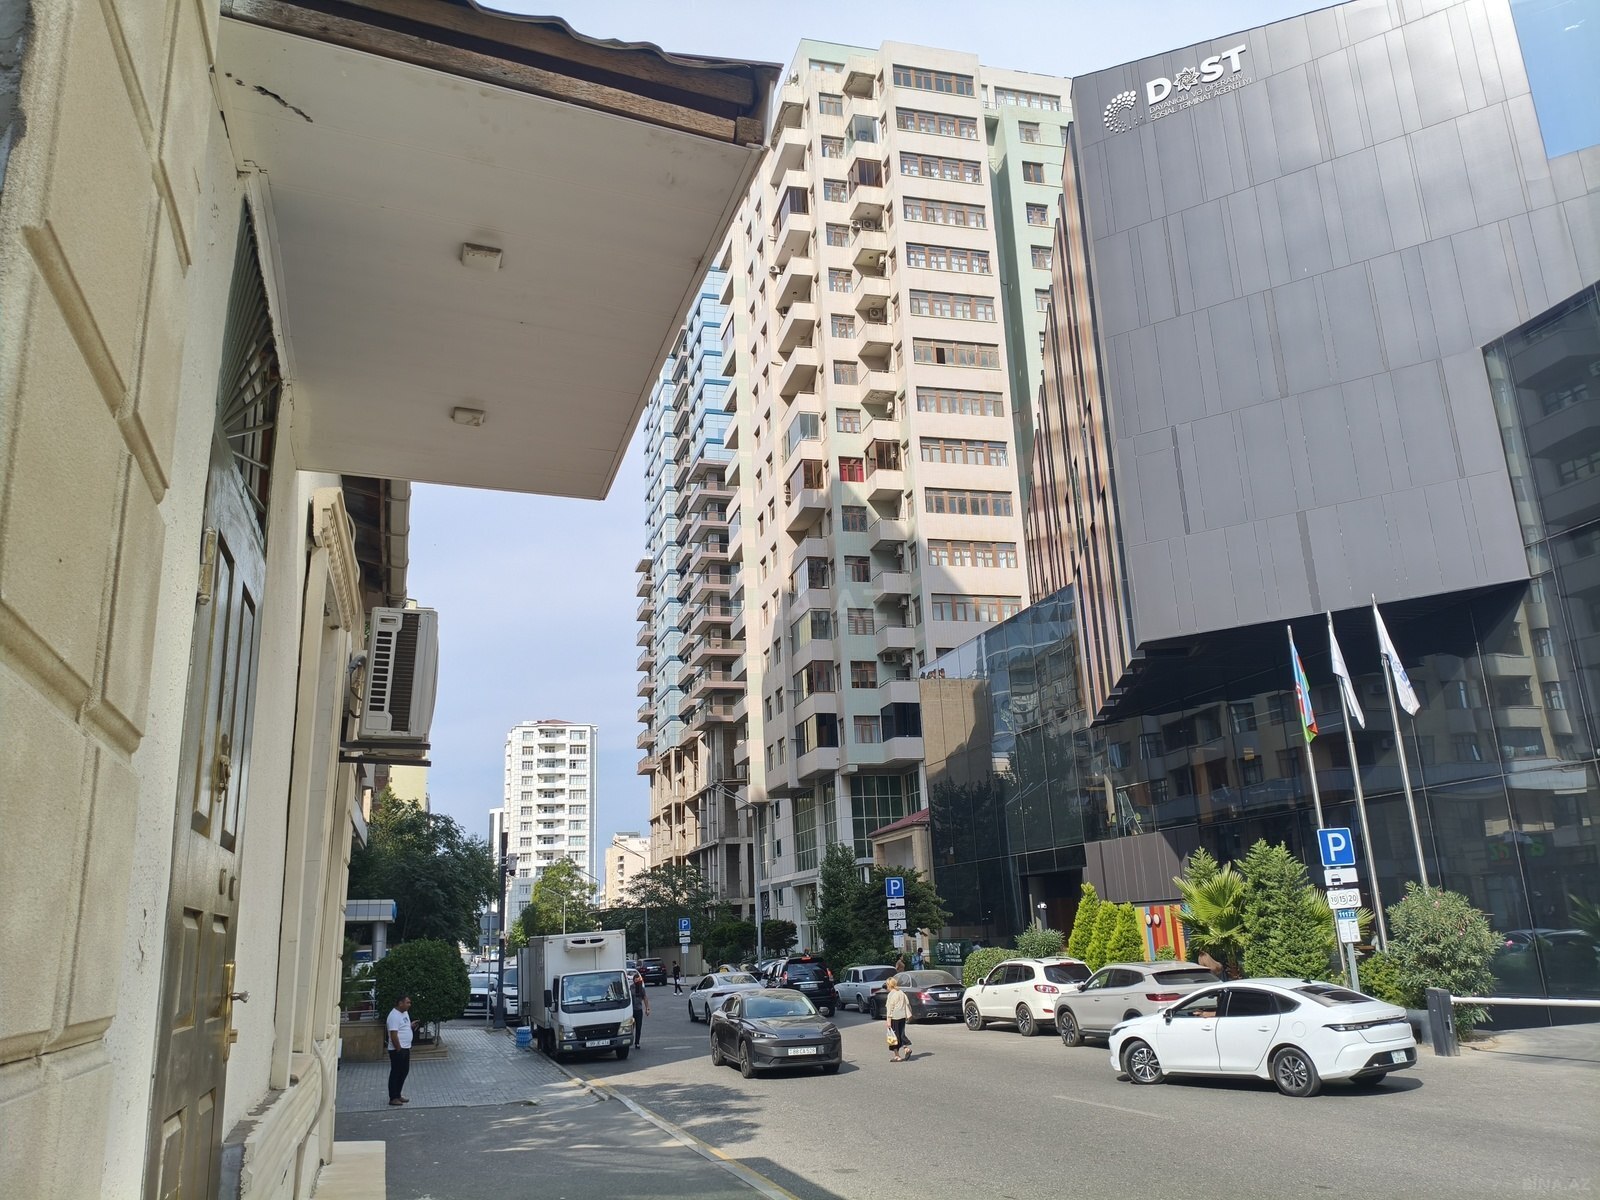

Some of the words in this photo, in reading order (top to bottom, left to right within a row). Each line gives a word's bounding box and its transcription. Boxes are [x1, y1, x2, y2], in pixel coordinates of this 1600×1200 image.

[1327, 833, 1346, 861] P
[890, 880, 901, 895] P
[1331, 896, 1338, 904] 10
[1339, 895, 1347, 903] 15
[1348, 894, 1357, 902] 20
[681, 919, 689, 929] P
